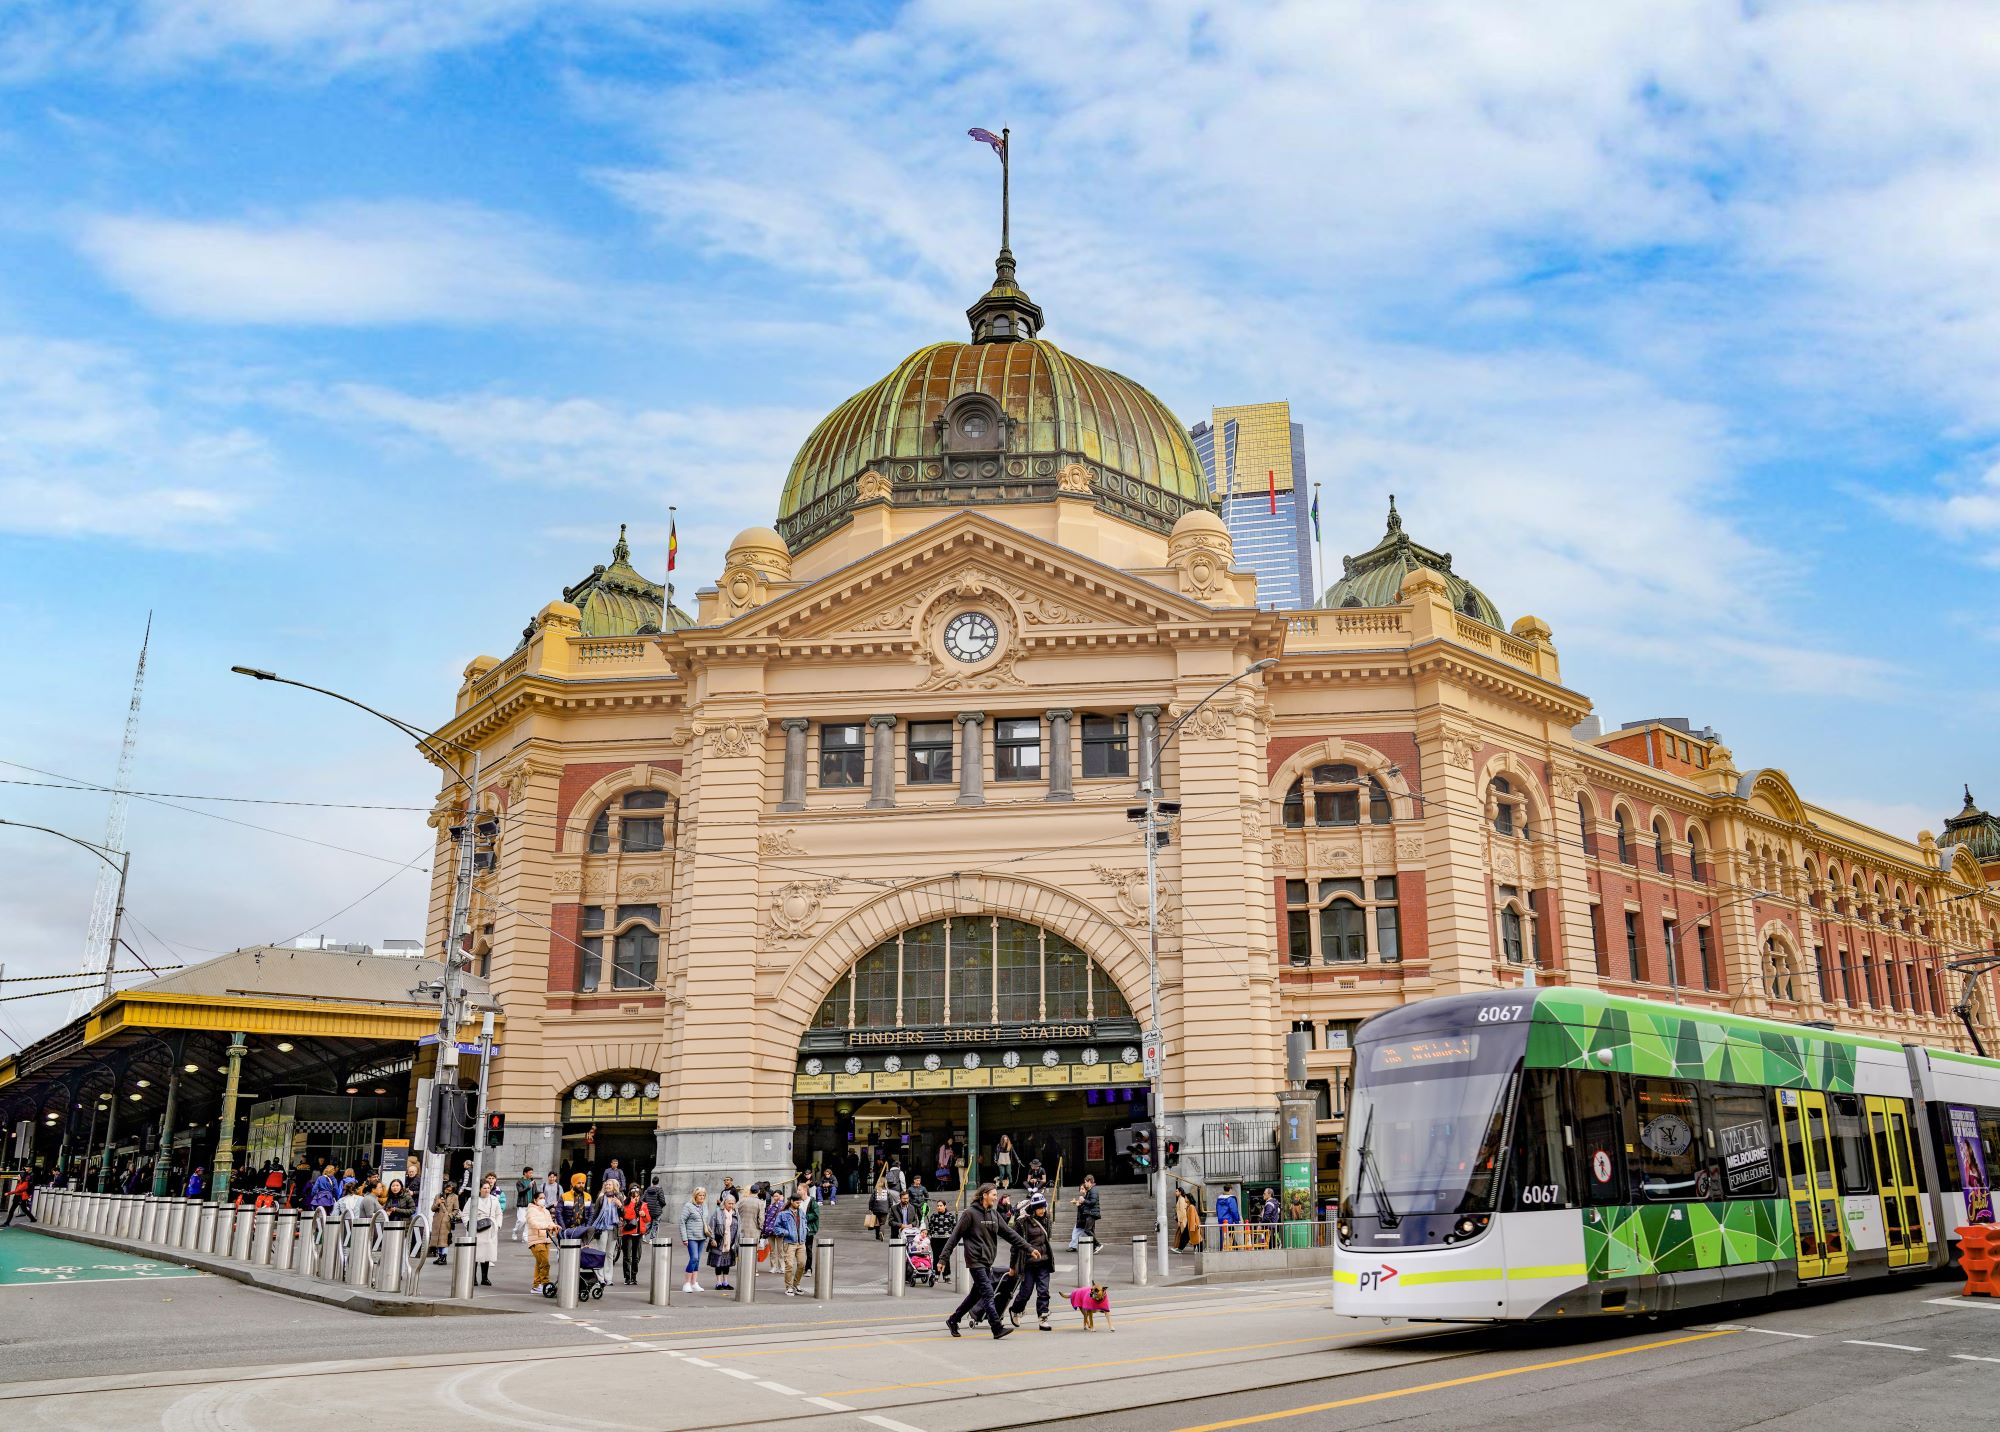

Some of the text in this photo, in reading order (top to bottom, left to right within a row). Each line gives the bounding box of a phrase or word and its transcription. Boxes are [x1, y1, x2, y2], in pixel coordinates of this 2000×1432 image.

[1478, 1005, 1523, 1022] 6067
[849, 1025, 1089, 1045] FLINDERS STREET STATION
[1721, 1126, 1754, 1154] MADE
[1753, 1124, 1766, 1146] IN
[1727, 1147, 1767, 1168] MELBOURNE
[1729, 1165, 1771, 1187] FOR MELBOURNE
[1522, 1184, 1559, 1204] 6067
